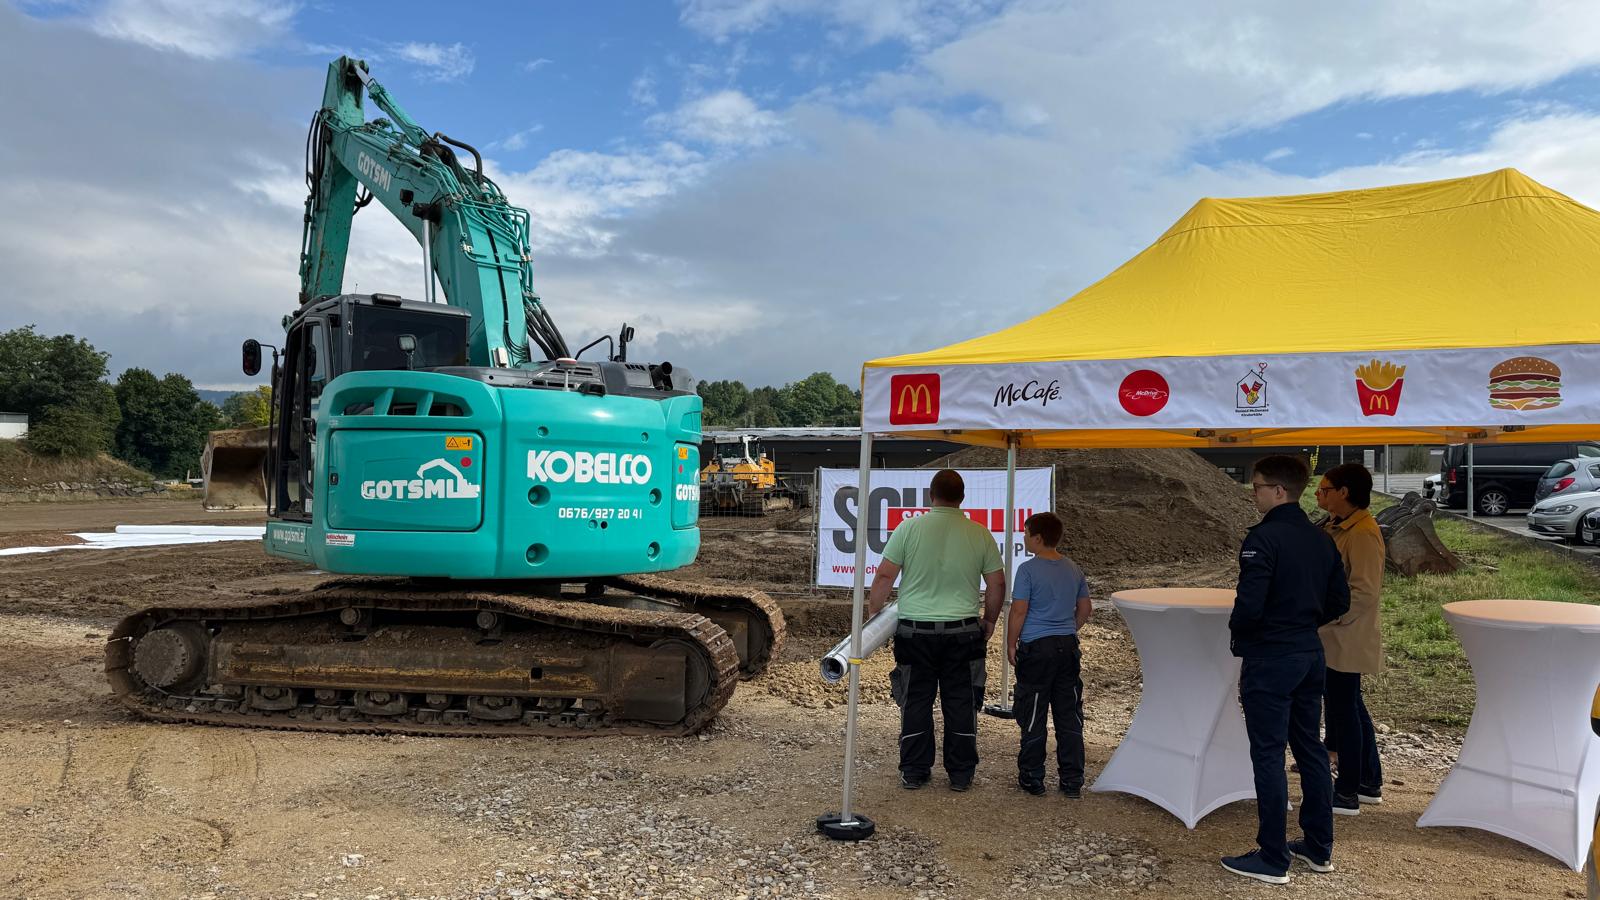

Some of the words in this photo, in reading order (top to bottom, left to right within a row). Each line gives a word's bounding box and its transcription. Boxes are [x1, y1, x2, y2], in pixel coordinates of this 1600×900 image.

[358, 151, 391, 192] GOTSMI
[994, 380, 1060, 407] McCafé
[527, 450, 652, 485] KOBELCO
[558, 507, 615, 519] 0676/927
[618, 508, 630, 519] 20
[633, 509, 642, 519] 41
